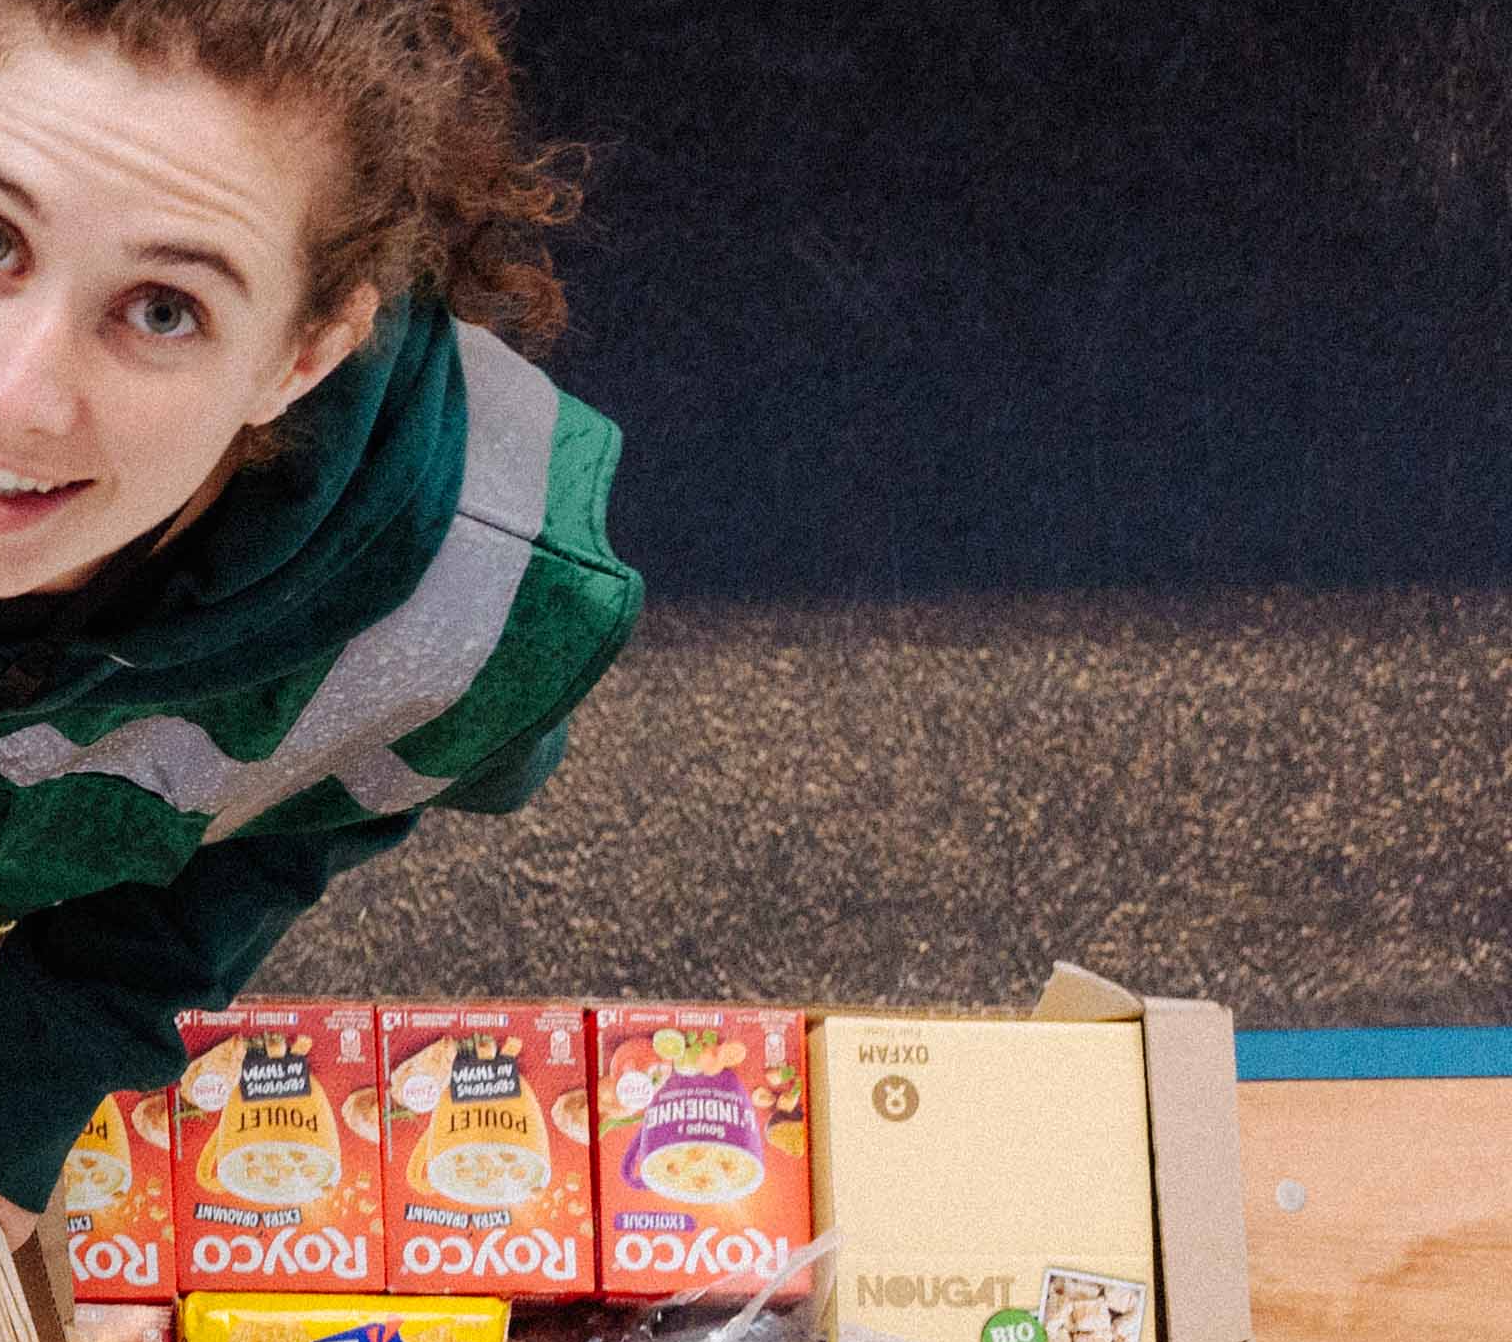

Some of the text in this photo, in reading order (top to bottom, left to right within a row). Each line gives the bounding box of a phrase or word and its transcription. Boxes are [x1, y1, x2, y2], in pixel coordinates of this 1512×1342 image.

[858, 1043, 929, 1066] OXFAM
[236, 1106, 318, 1134] POULET
[447, 1107, 528, 1134] POULET
[195, 1203, 301, 1229] EXTRA CRAQUANT
[405, 1204, 511, 1230] EXTRA CRAQUANT
[621, 1213, 686, 1231] EXOTIQUE
[193, 1226, 368, 1279] Royco
[403, 1228, 577, 1280] Royco
[615, 1226, 789, 1278] Royco
[857, 1275, 1016, 1308] NOUGAT
